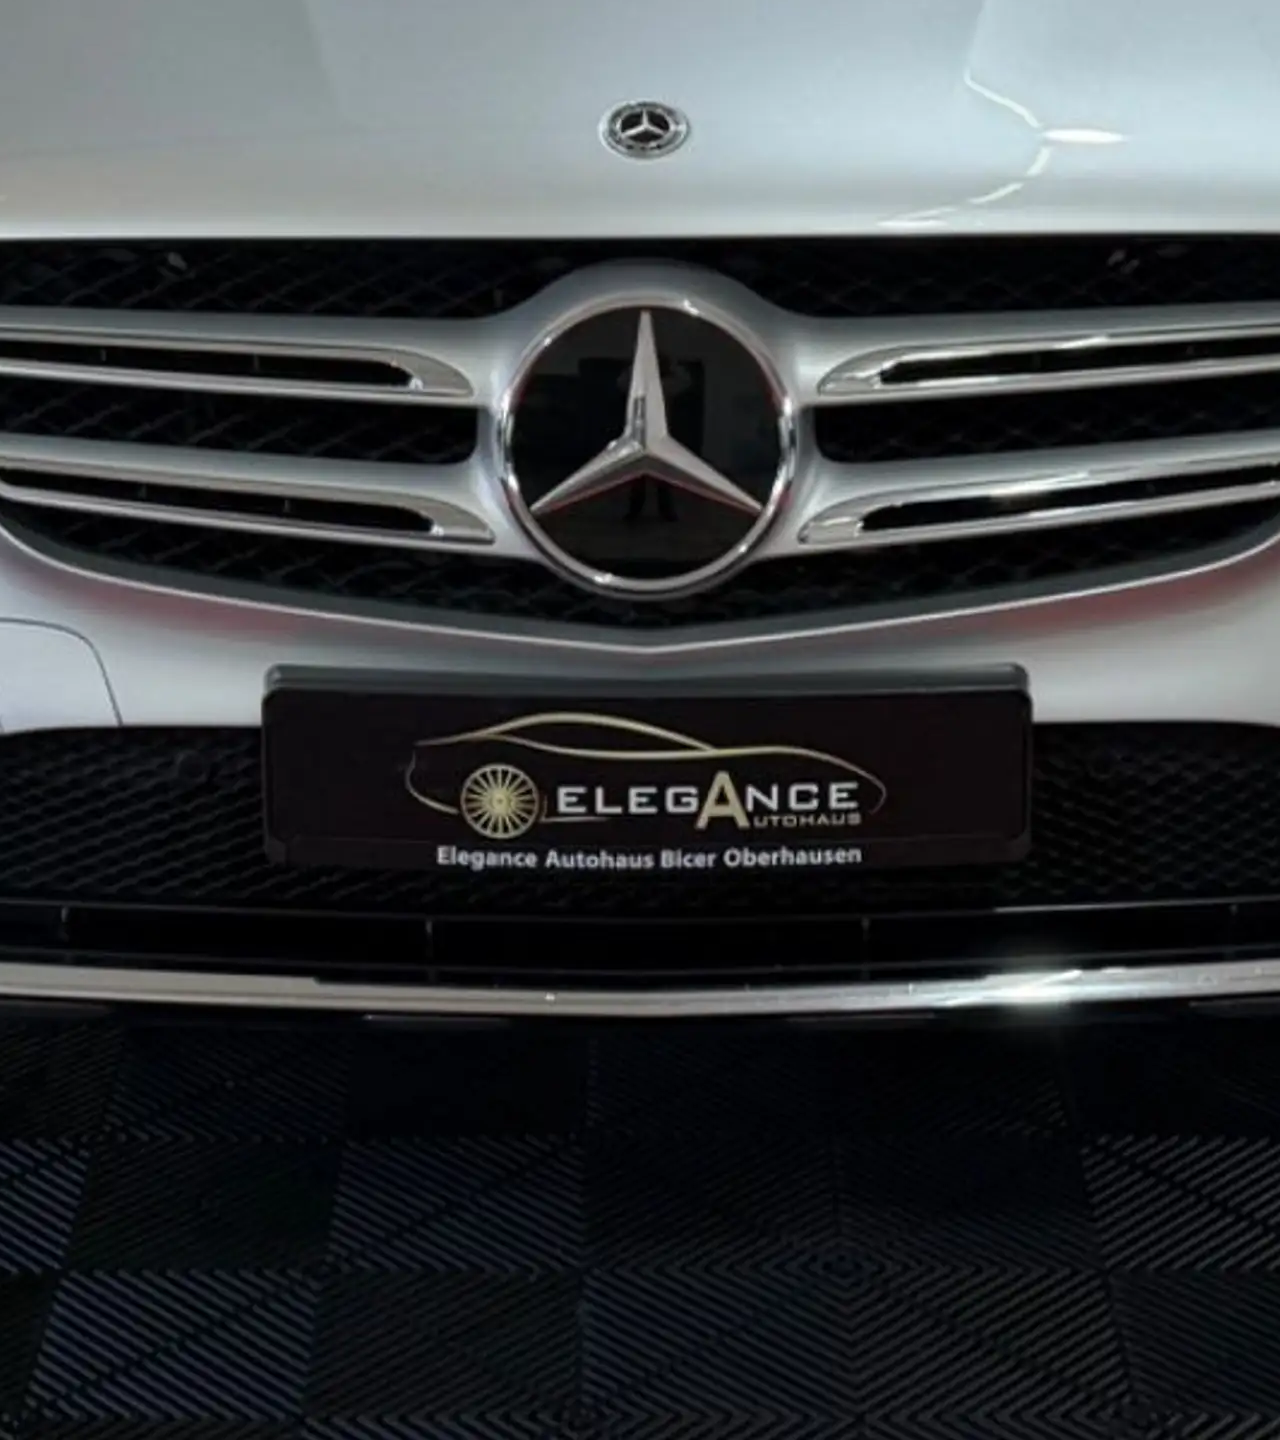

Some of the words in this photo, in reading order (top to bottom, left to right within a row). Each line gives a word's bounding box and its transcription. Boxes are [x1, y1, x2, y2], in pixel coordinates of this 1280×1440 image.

[556, 770, 860, 830] ELEGANCE
[436, 845, 539, 872] Elegance
[544, 849, 655, 869] Autohaus
[722, 846, 863, 868] Oberhausen
